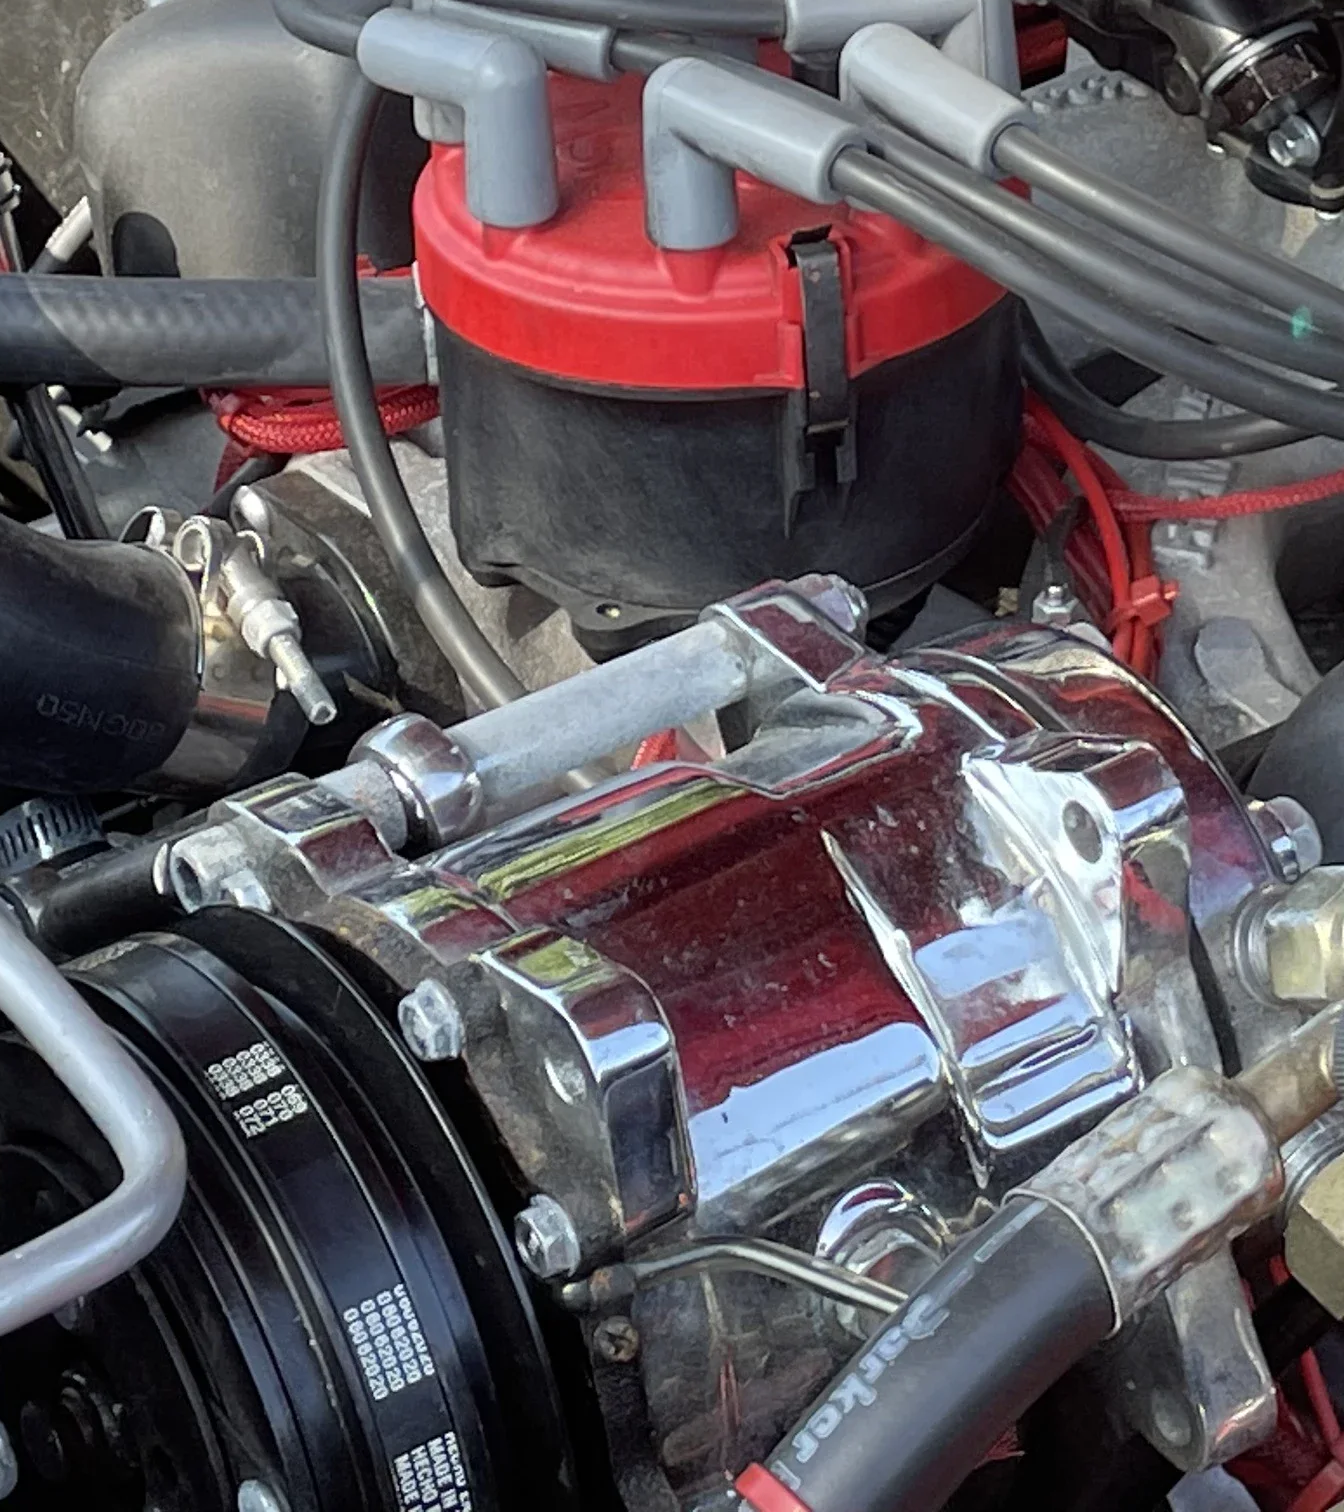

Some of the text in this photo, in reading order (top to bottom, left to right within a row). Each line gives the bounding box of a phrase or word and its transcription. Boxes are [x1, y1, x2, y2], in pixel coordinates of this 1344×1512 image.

[793, 1293, 952, 1465] Parker
[393, 1453, 421, 1505] MADE
[410, 1444, 439, 1503] HECHO
[426, 1436, 453, 1487] MADE
